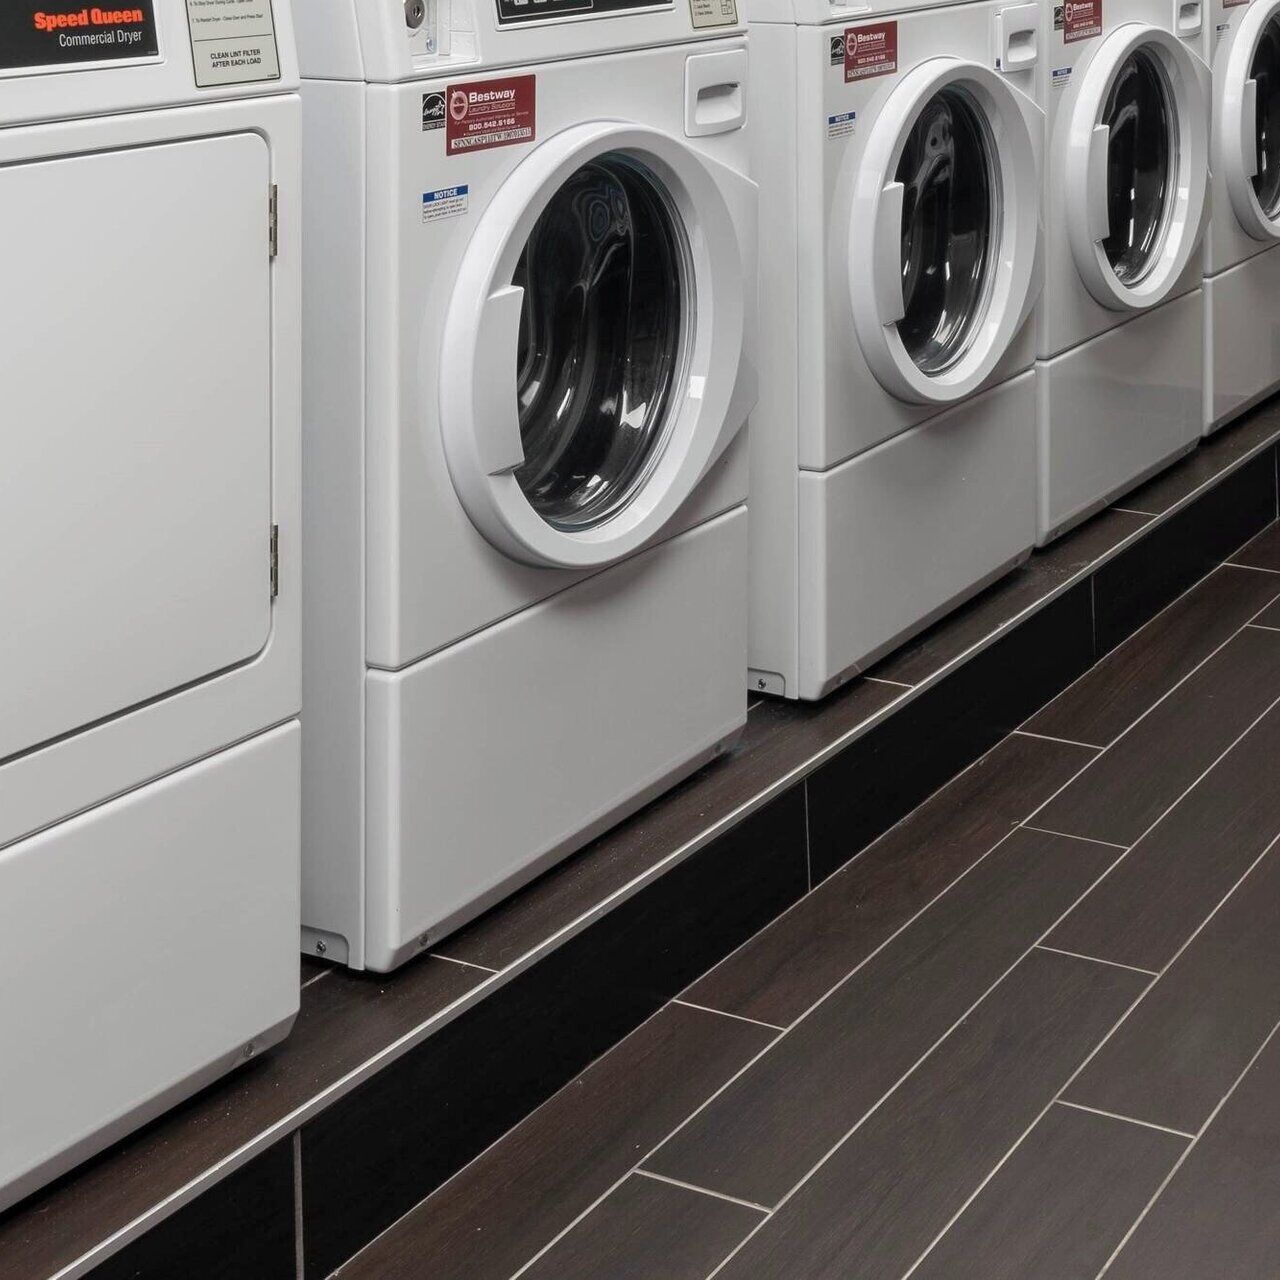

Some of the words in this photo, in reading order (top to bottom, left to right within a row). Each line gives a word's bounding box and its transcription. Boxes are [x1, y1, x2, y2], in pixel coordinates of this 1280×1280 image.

[34, 9, 89, 32] Speed
[91, 8, 142, 24] Queen
[59, 31, 115, 47] Commercial
[117, 29, 142, 45] Dryer
[857, 32, 885, 43] Bestway
[210, 52, 229, 60] CLEAN
[230, 50, 242, 58] LINT
[242, 48, 260, 56] FILTER
[212, 60, 230, 68] AFTER
[246, 57, 262, 65] LOAD
[469, 88, 516, 103] Bestway
[434, 188, 458, 200] NOTICE
